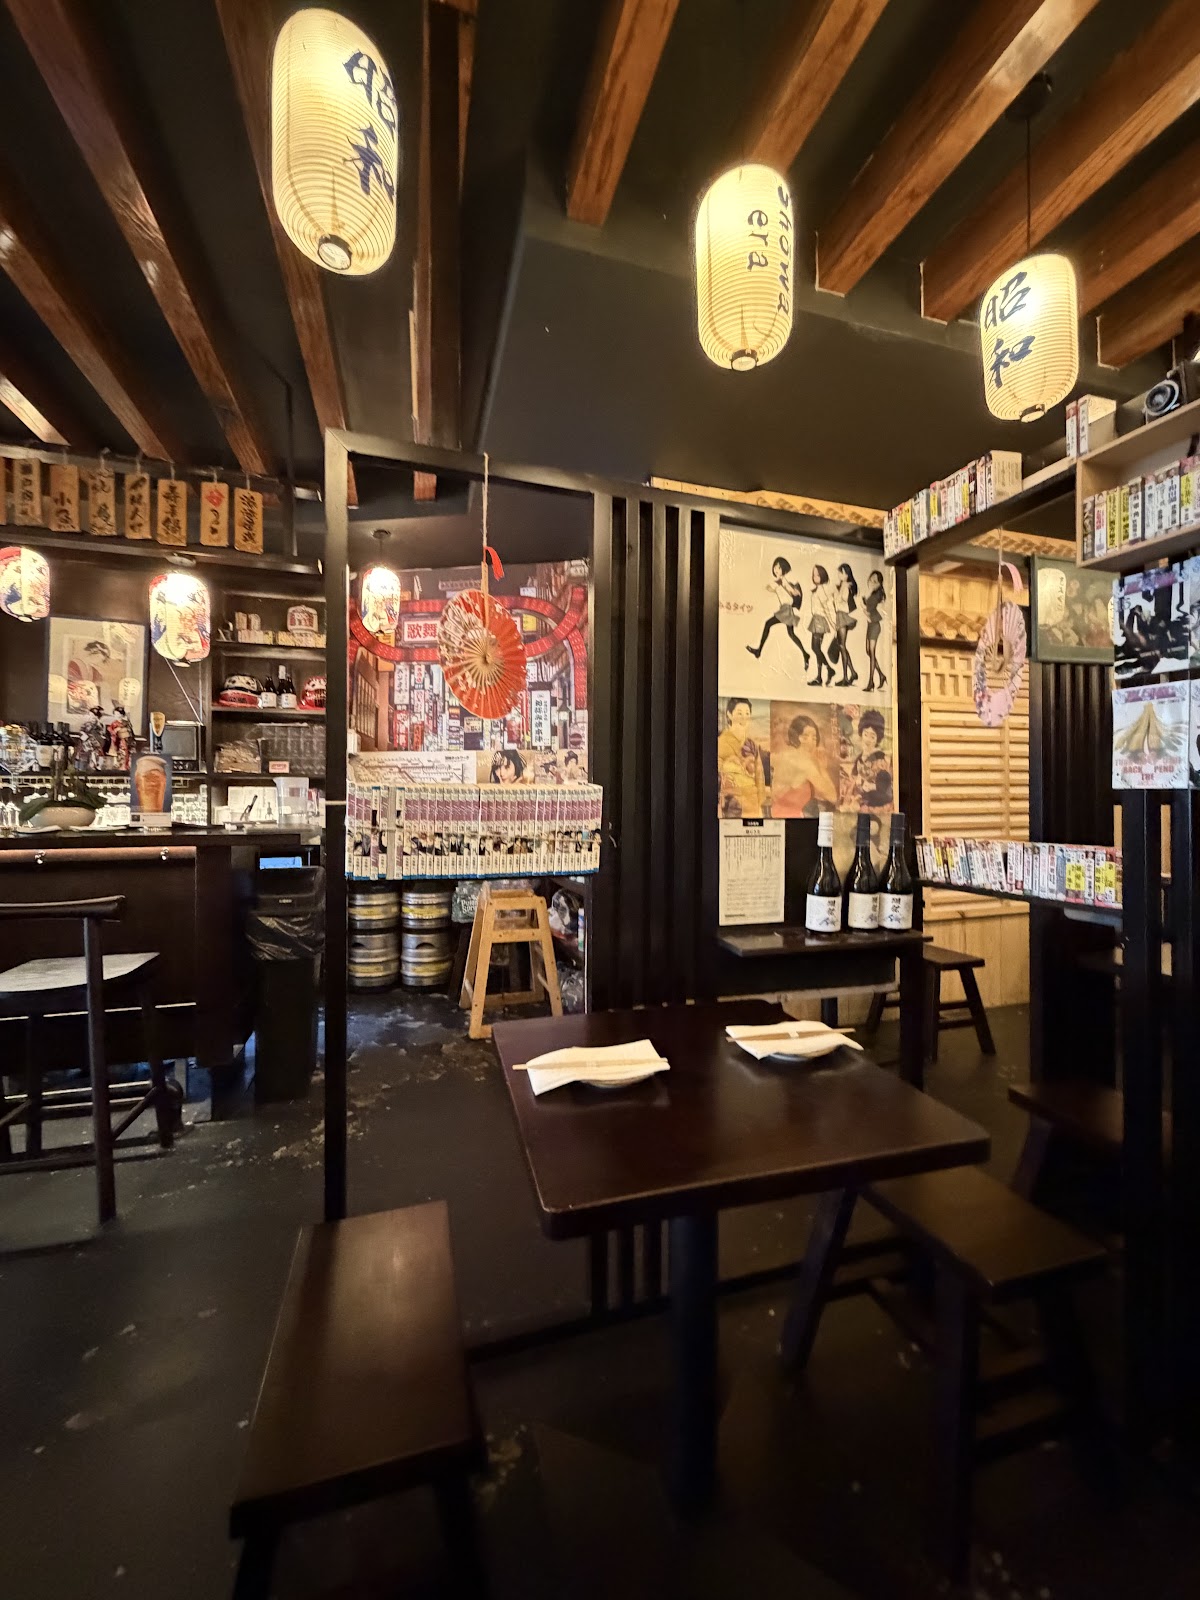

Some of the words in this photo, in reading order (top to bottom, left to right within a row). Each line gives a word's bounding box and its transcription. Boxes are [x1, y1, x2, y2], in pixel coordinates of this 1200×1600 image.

[747, 209, 769, 272] era
[984, 271, 1036, 389] 昭和
[407, 622, 439, 639] 歌舞
